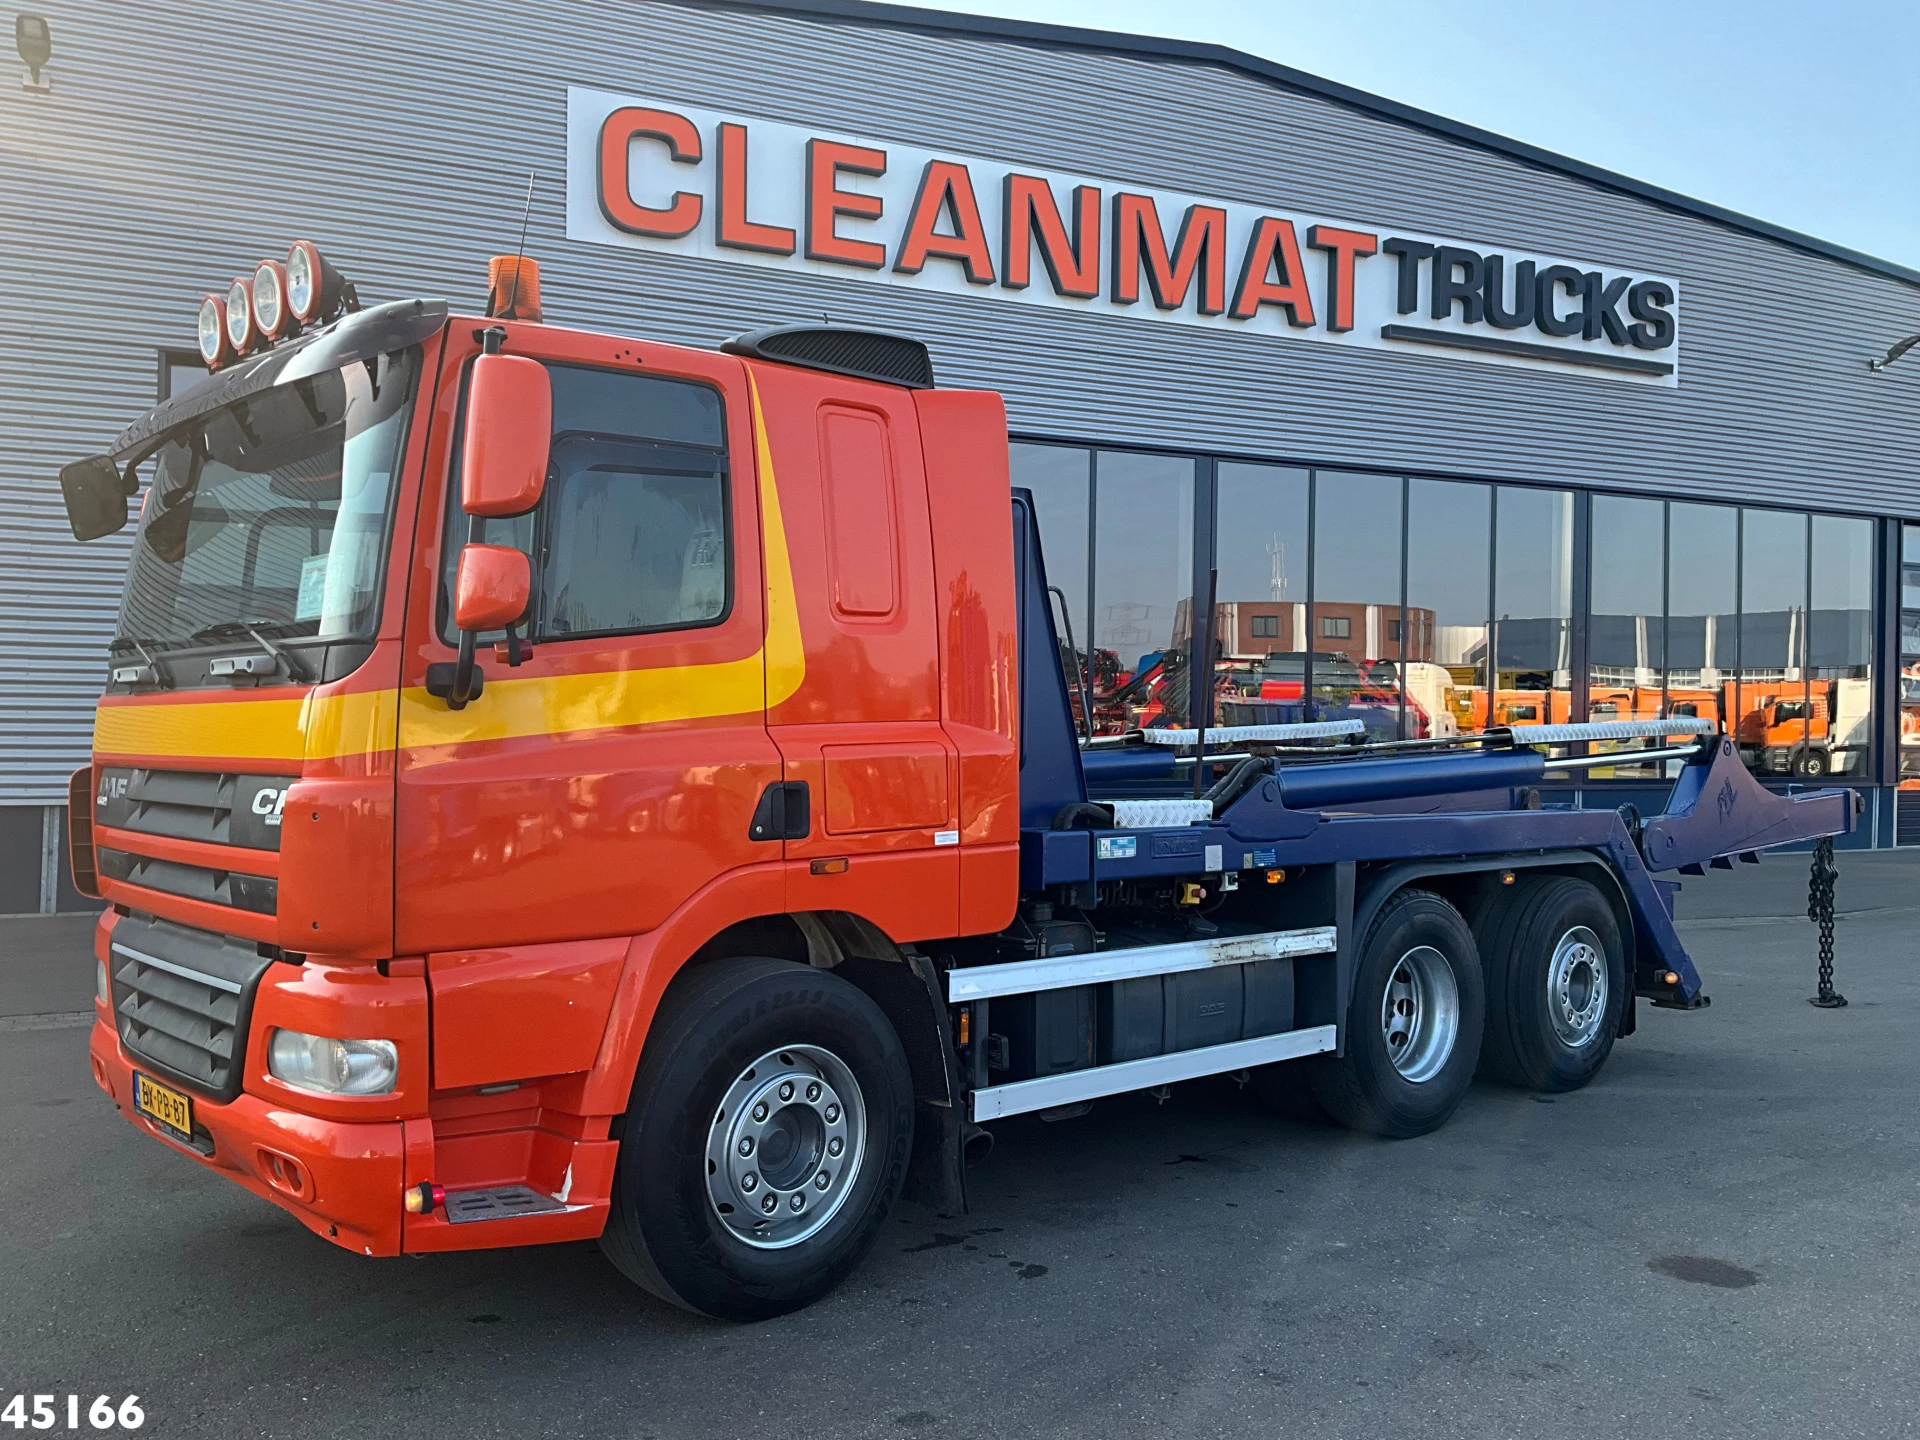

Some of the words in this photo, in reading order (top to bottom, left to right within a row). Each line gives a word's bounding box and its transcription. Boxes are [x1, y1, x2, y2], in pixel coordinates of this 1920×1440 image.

[597, 106, 1378, 333] CLEANMAT
[1383, 237, 1675, 350] TRUCKS
[141, 1080, 185, 1127] BX-PB-87
